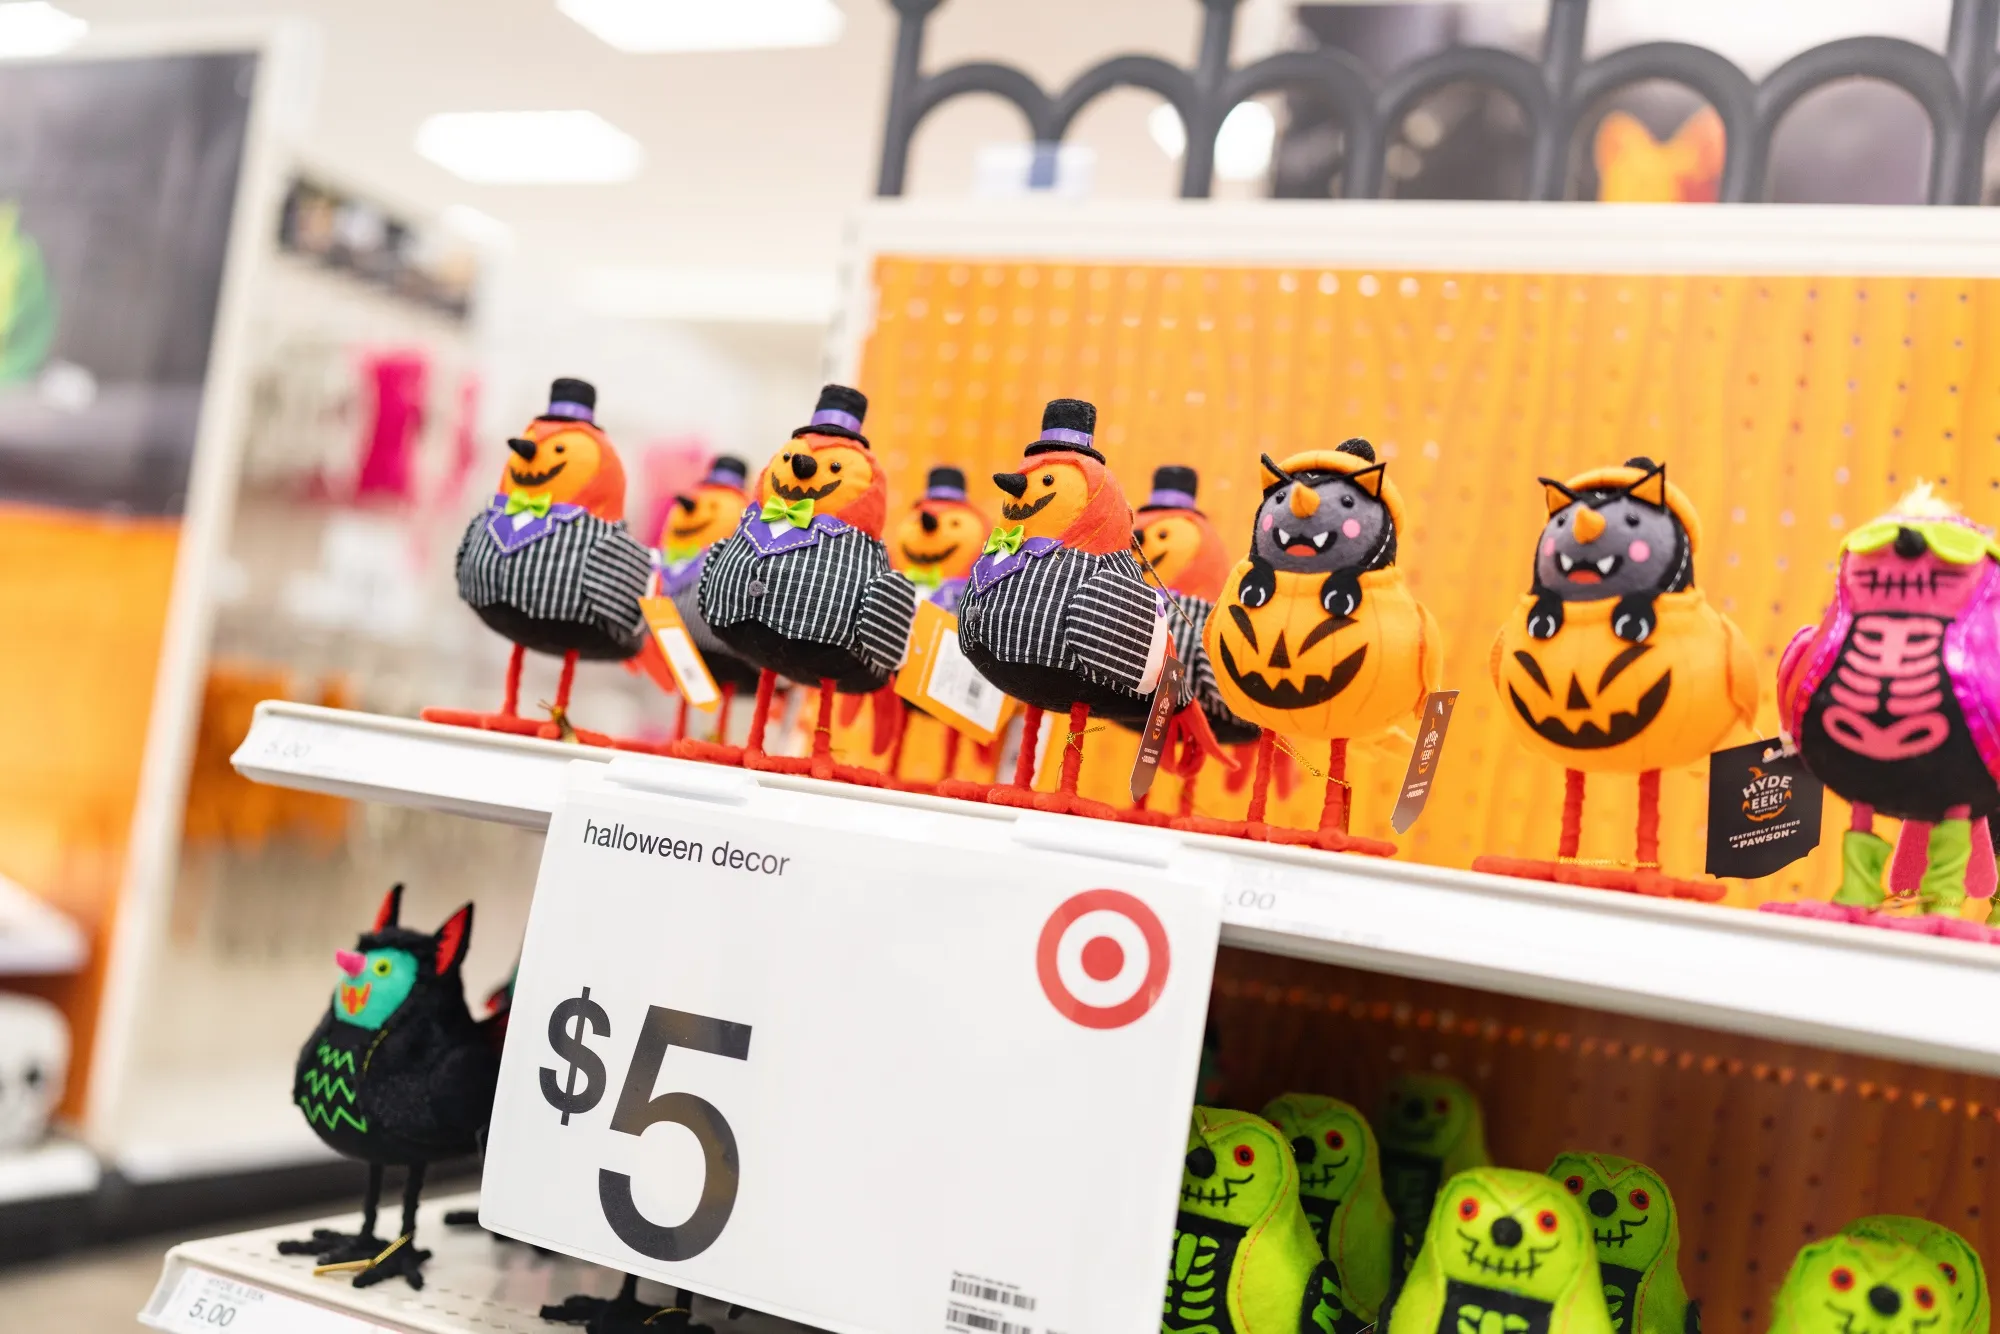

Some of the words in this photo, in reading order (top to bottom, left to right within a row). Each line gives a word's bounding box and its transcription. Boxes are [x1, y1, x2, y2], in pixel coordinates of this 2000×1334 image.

[1742, 775, 1793, 799] HYDE
[1751, 792, 1783, 811] EEK!
[1729, 827, 1770, 842] FEATHERLY
[1770, 819, 1801, 832] FRIENDS
[1739, 829, 1790, 849] PAWSON
[583, 818, 704, 863] halloween
[711, 840, 791, 877] decor
[1223, 889, 1276, 911] .00
[538, 985, 753, 1262] $5
[189, 1297, 237, 1328] 5.00
